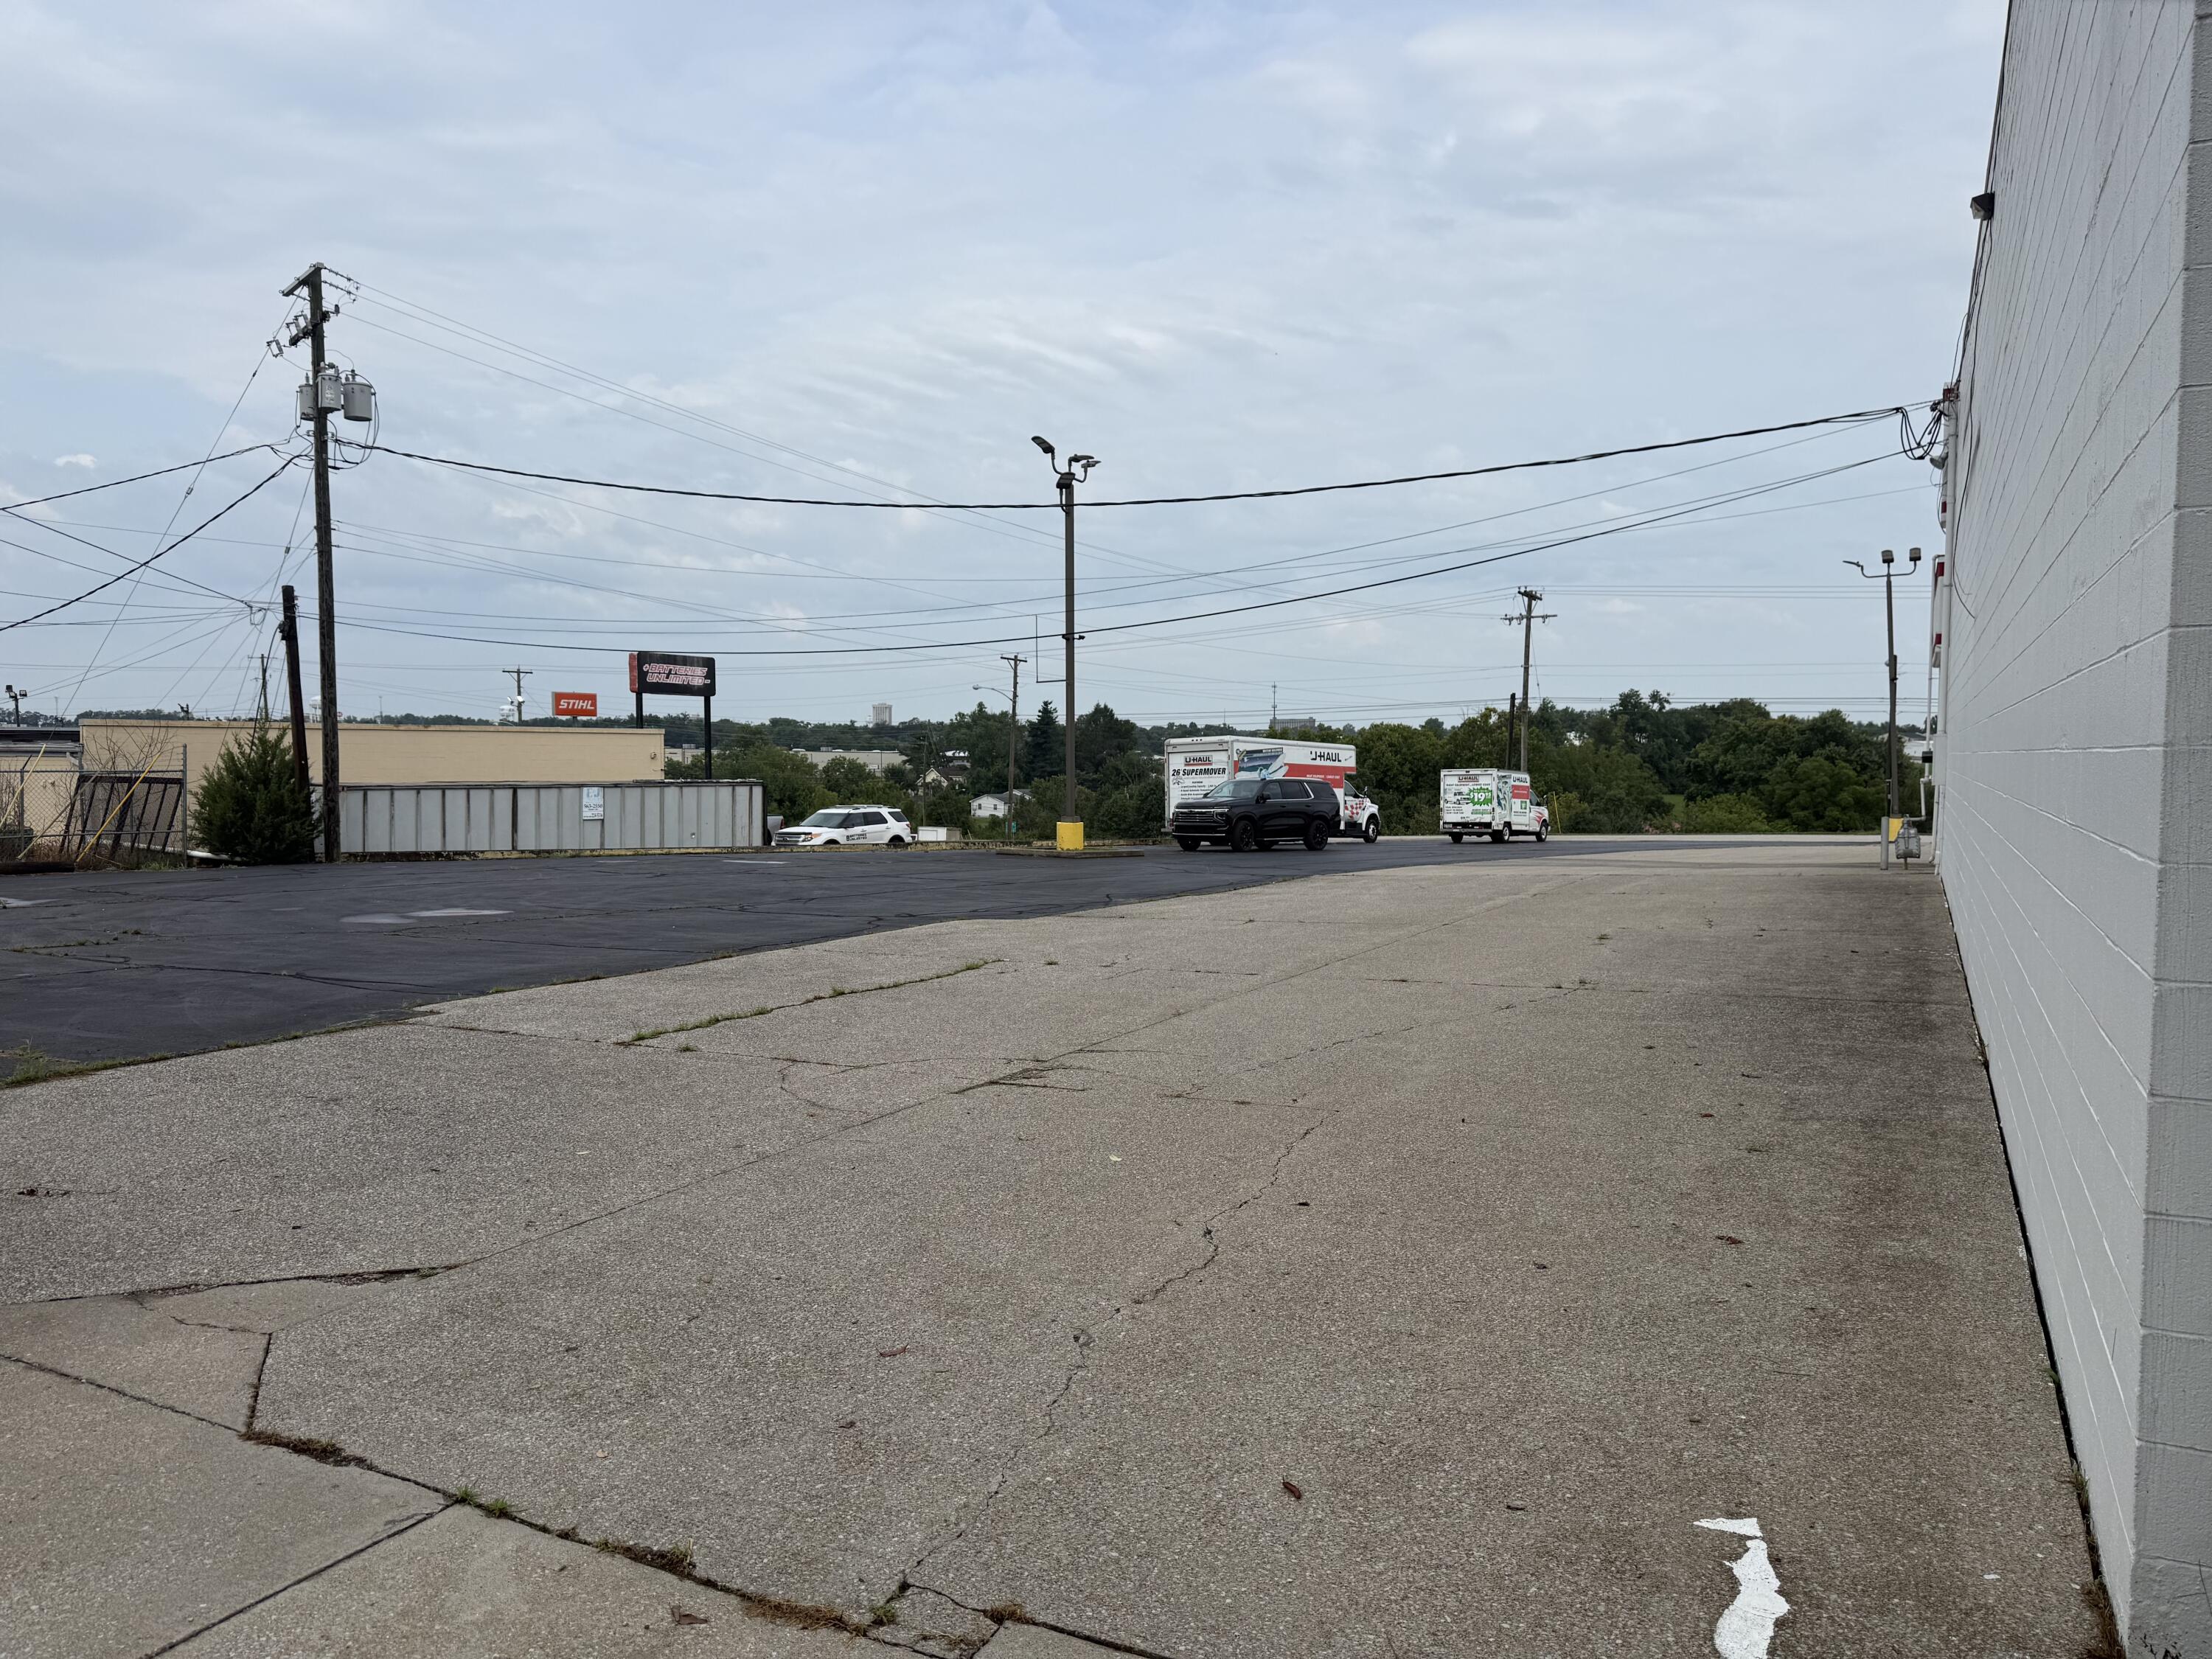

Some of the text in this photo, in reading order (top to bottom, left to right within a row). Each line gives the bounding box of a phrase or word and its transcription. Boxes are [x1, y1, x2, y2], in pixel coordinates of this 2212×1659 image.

[558, 699, 595, 710] STIHL
[1310, 751, 1342, 762] U-HAUL
[1182, 768, 1226, 776] SUPERMOVER
